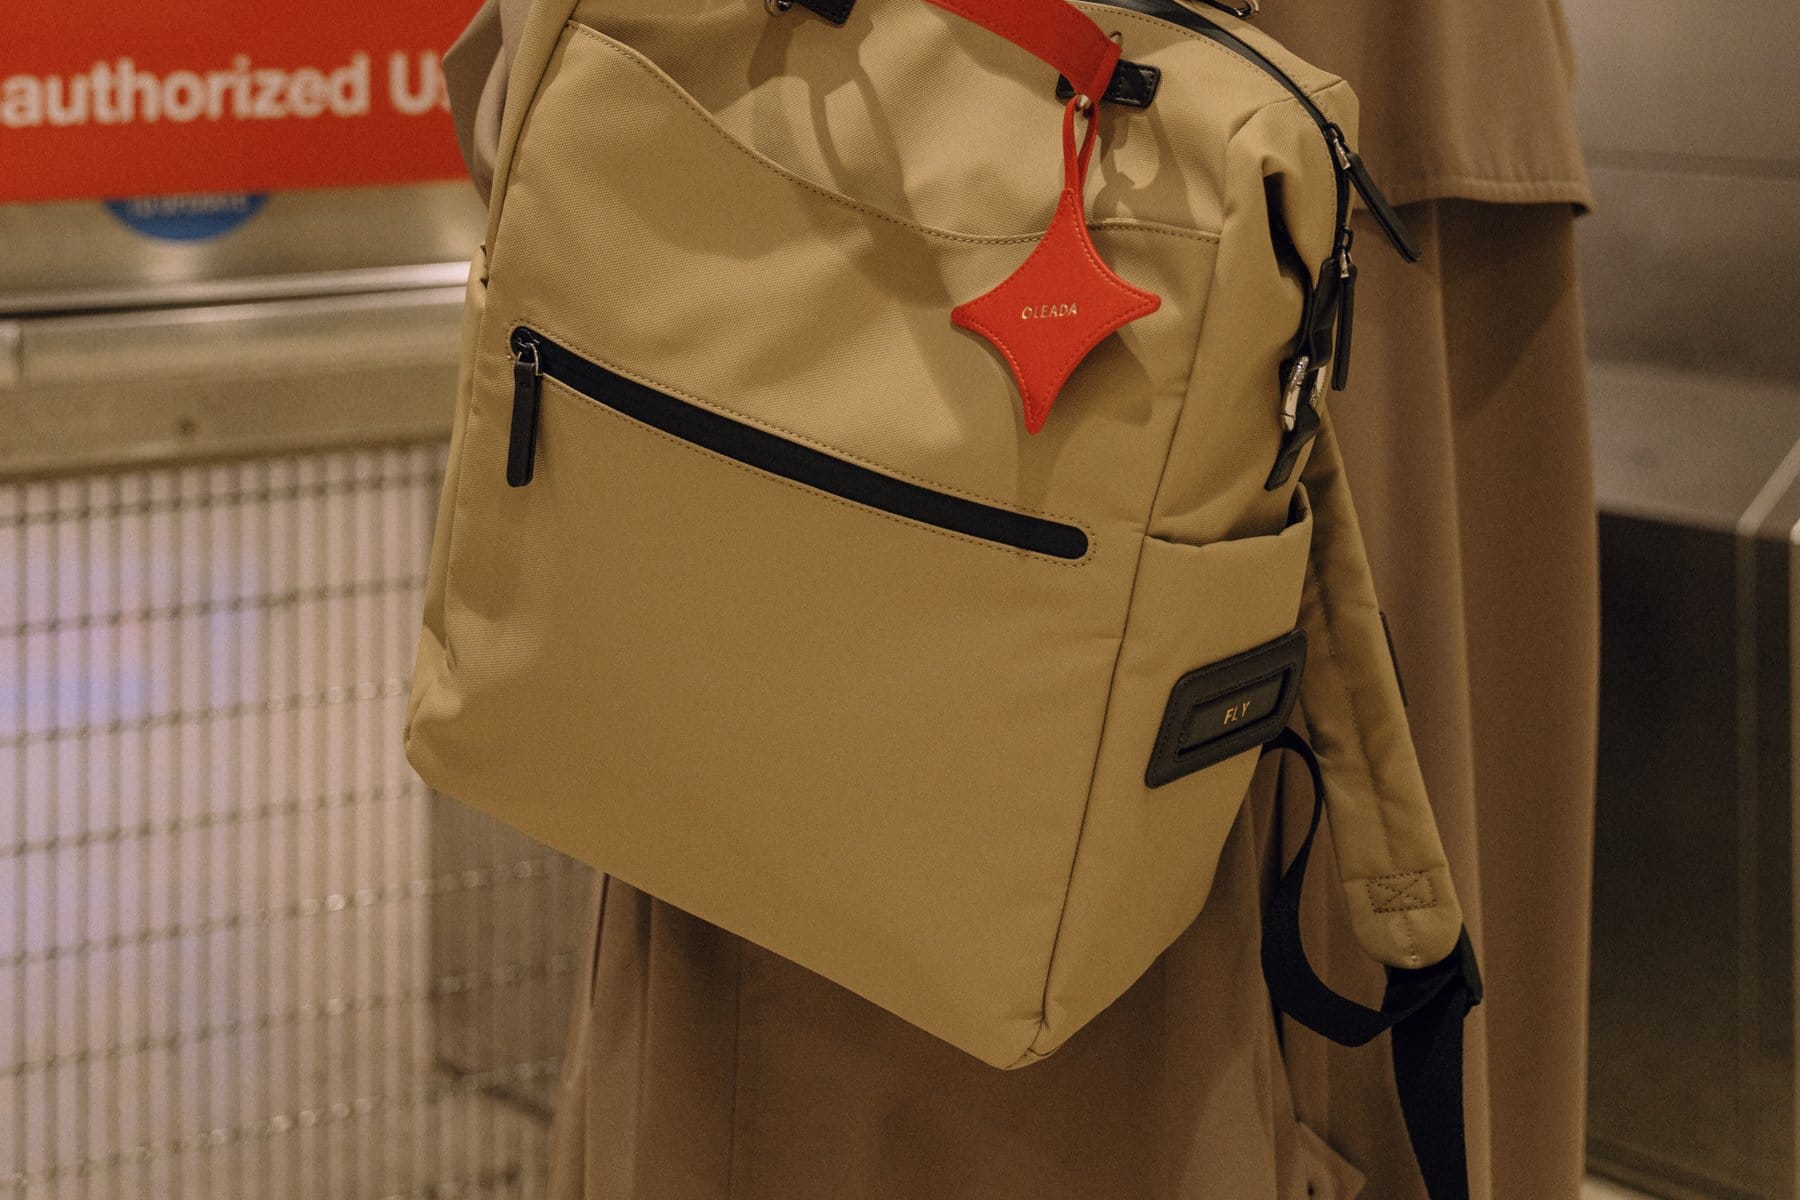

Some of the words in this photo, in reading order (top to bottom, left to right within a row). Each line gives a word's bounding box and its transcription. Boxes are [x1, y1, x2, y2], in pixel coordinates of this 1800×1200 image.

[1, 50, 371, 127] authorized
[387, 50, 451, 115] U
[1021, 302, 1078, 320] OLEADA
[1223, 700, 1251, 725] FLY
